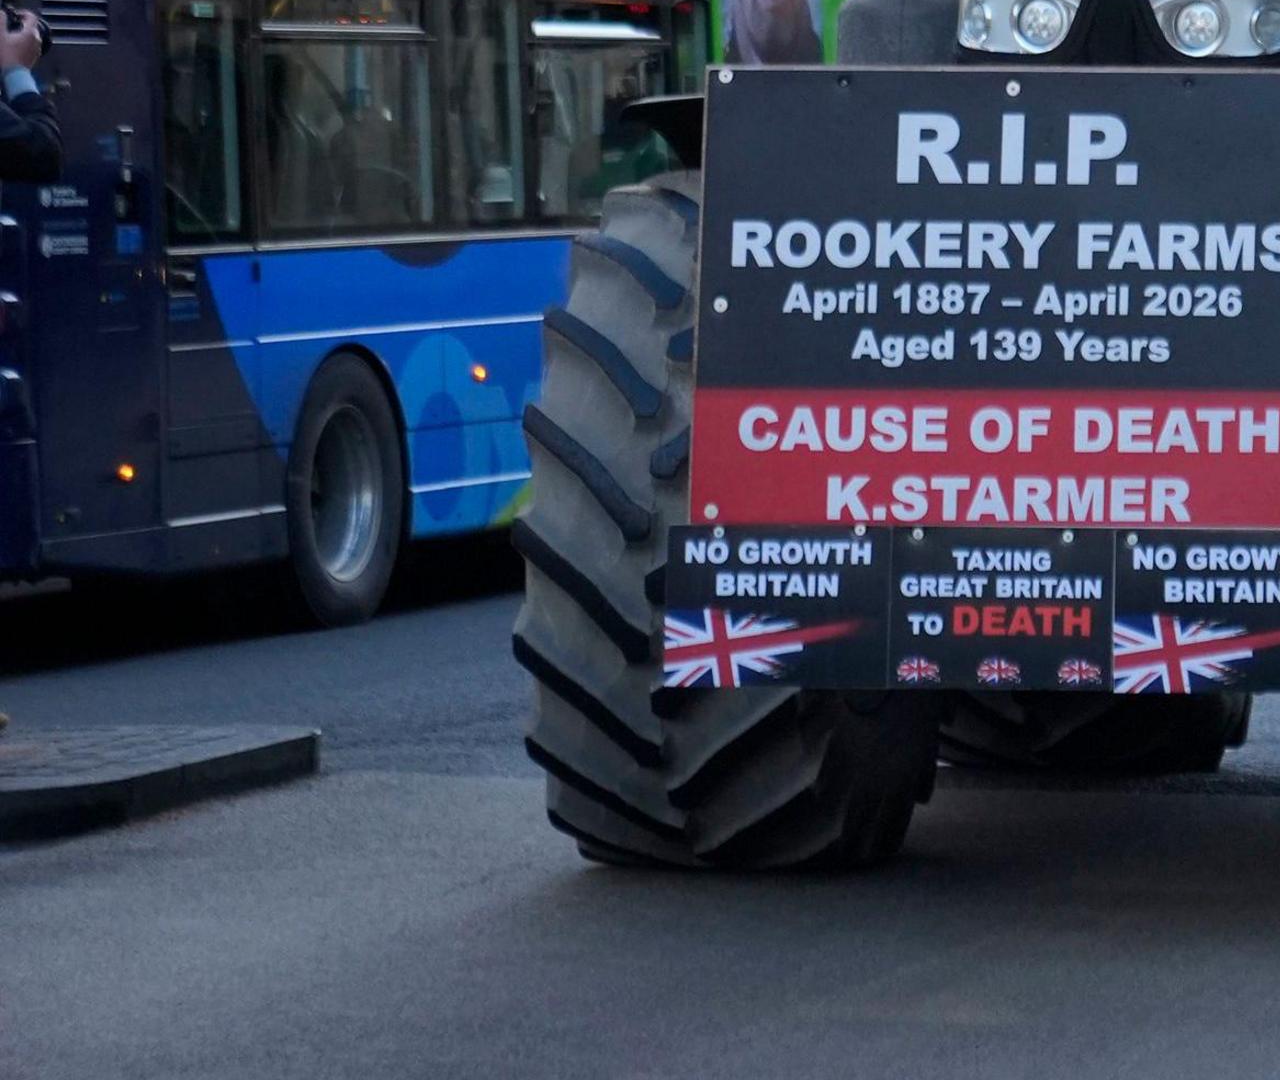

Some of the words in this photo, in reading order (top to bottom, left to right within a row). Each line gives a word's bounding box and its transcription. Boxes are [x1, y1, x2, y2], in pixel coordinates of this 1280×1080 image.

[896, 114, 1138, 186] R.I.P.
[731, 221, 1061, 270] ROOKERY
[783, 282, 878, 319] April
[893, 283, 990, 315] 1887
[1034, 285, 1129, 322] April
[1143, 286, 1242, 318] 2026
[851, 330, 954, 367] Aged
[969, 331, 1041, 361] 139
[1056, 332, 1170, 363] Years
[738, 407, 948, 452] CAUSE
[969, 408, 1051, 453] OF
[1074, 409, 1280, 453] DEATH
[826, 476, 1191, 522] K.STARMER
[685, 540, 729, 564] NO
[738, 540, 873, 566] GROWTH
[953, 549, 1052, 572] TAXING
[1133, 546, 1177, 570] NO
[716, 574, 839, 598] BRITAIN
[900, 576, 988, 598] GREAT
[996, 577, 1102, 599] BRITAIN
[908, 615, 943, 635] TO
[953, 607, 1092, 637] DEATH
